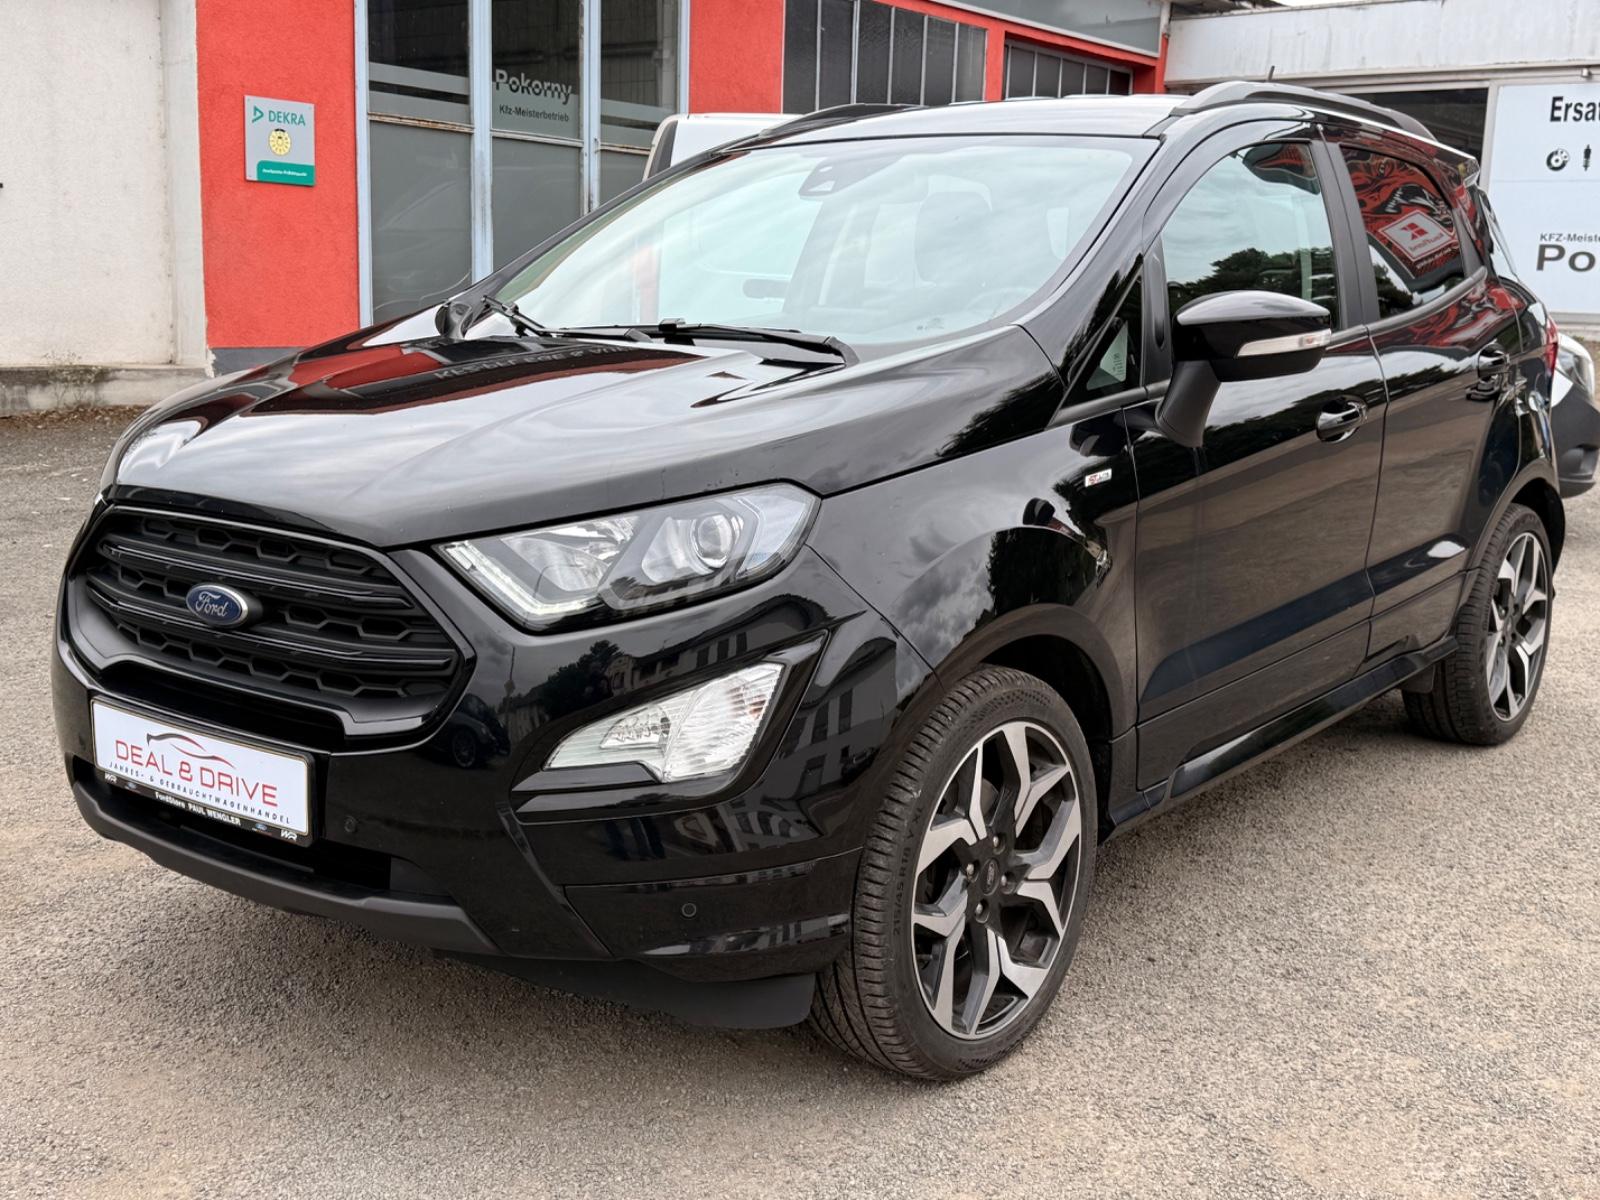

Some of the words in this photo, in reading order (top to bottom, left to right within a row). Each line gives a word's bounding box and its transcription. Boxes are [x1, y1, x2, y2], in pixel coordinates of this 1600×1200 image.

[495, 69, 572, 105] Pokorny
[268, 109, 306, 127] DEKRA
[499, 104, 569, 122] Kfz-Meisterbetrieb
[1539, 232, 1600, 243] KFZ-Meist
[195, 590, 229, 617] Ford
[115, 739, 172, 777] DEAL
[178, 760, 193, 782] &
[200, 767, 278, 808] DRIVE
[109, 761, 144, 777] JAHRES-
[160, 778, 291, 825] GEBRAUCHTWAGENHANDEL
[188, 801, 206, 817] PAUL
